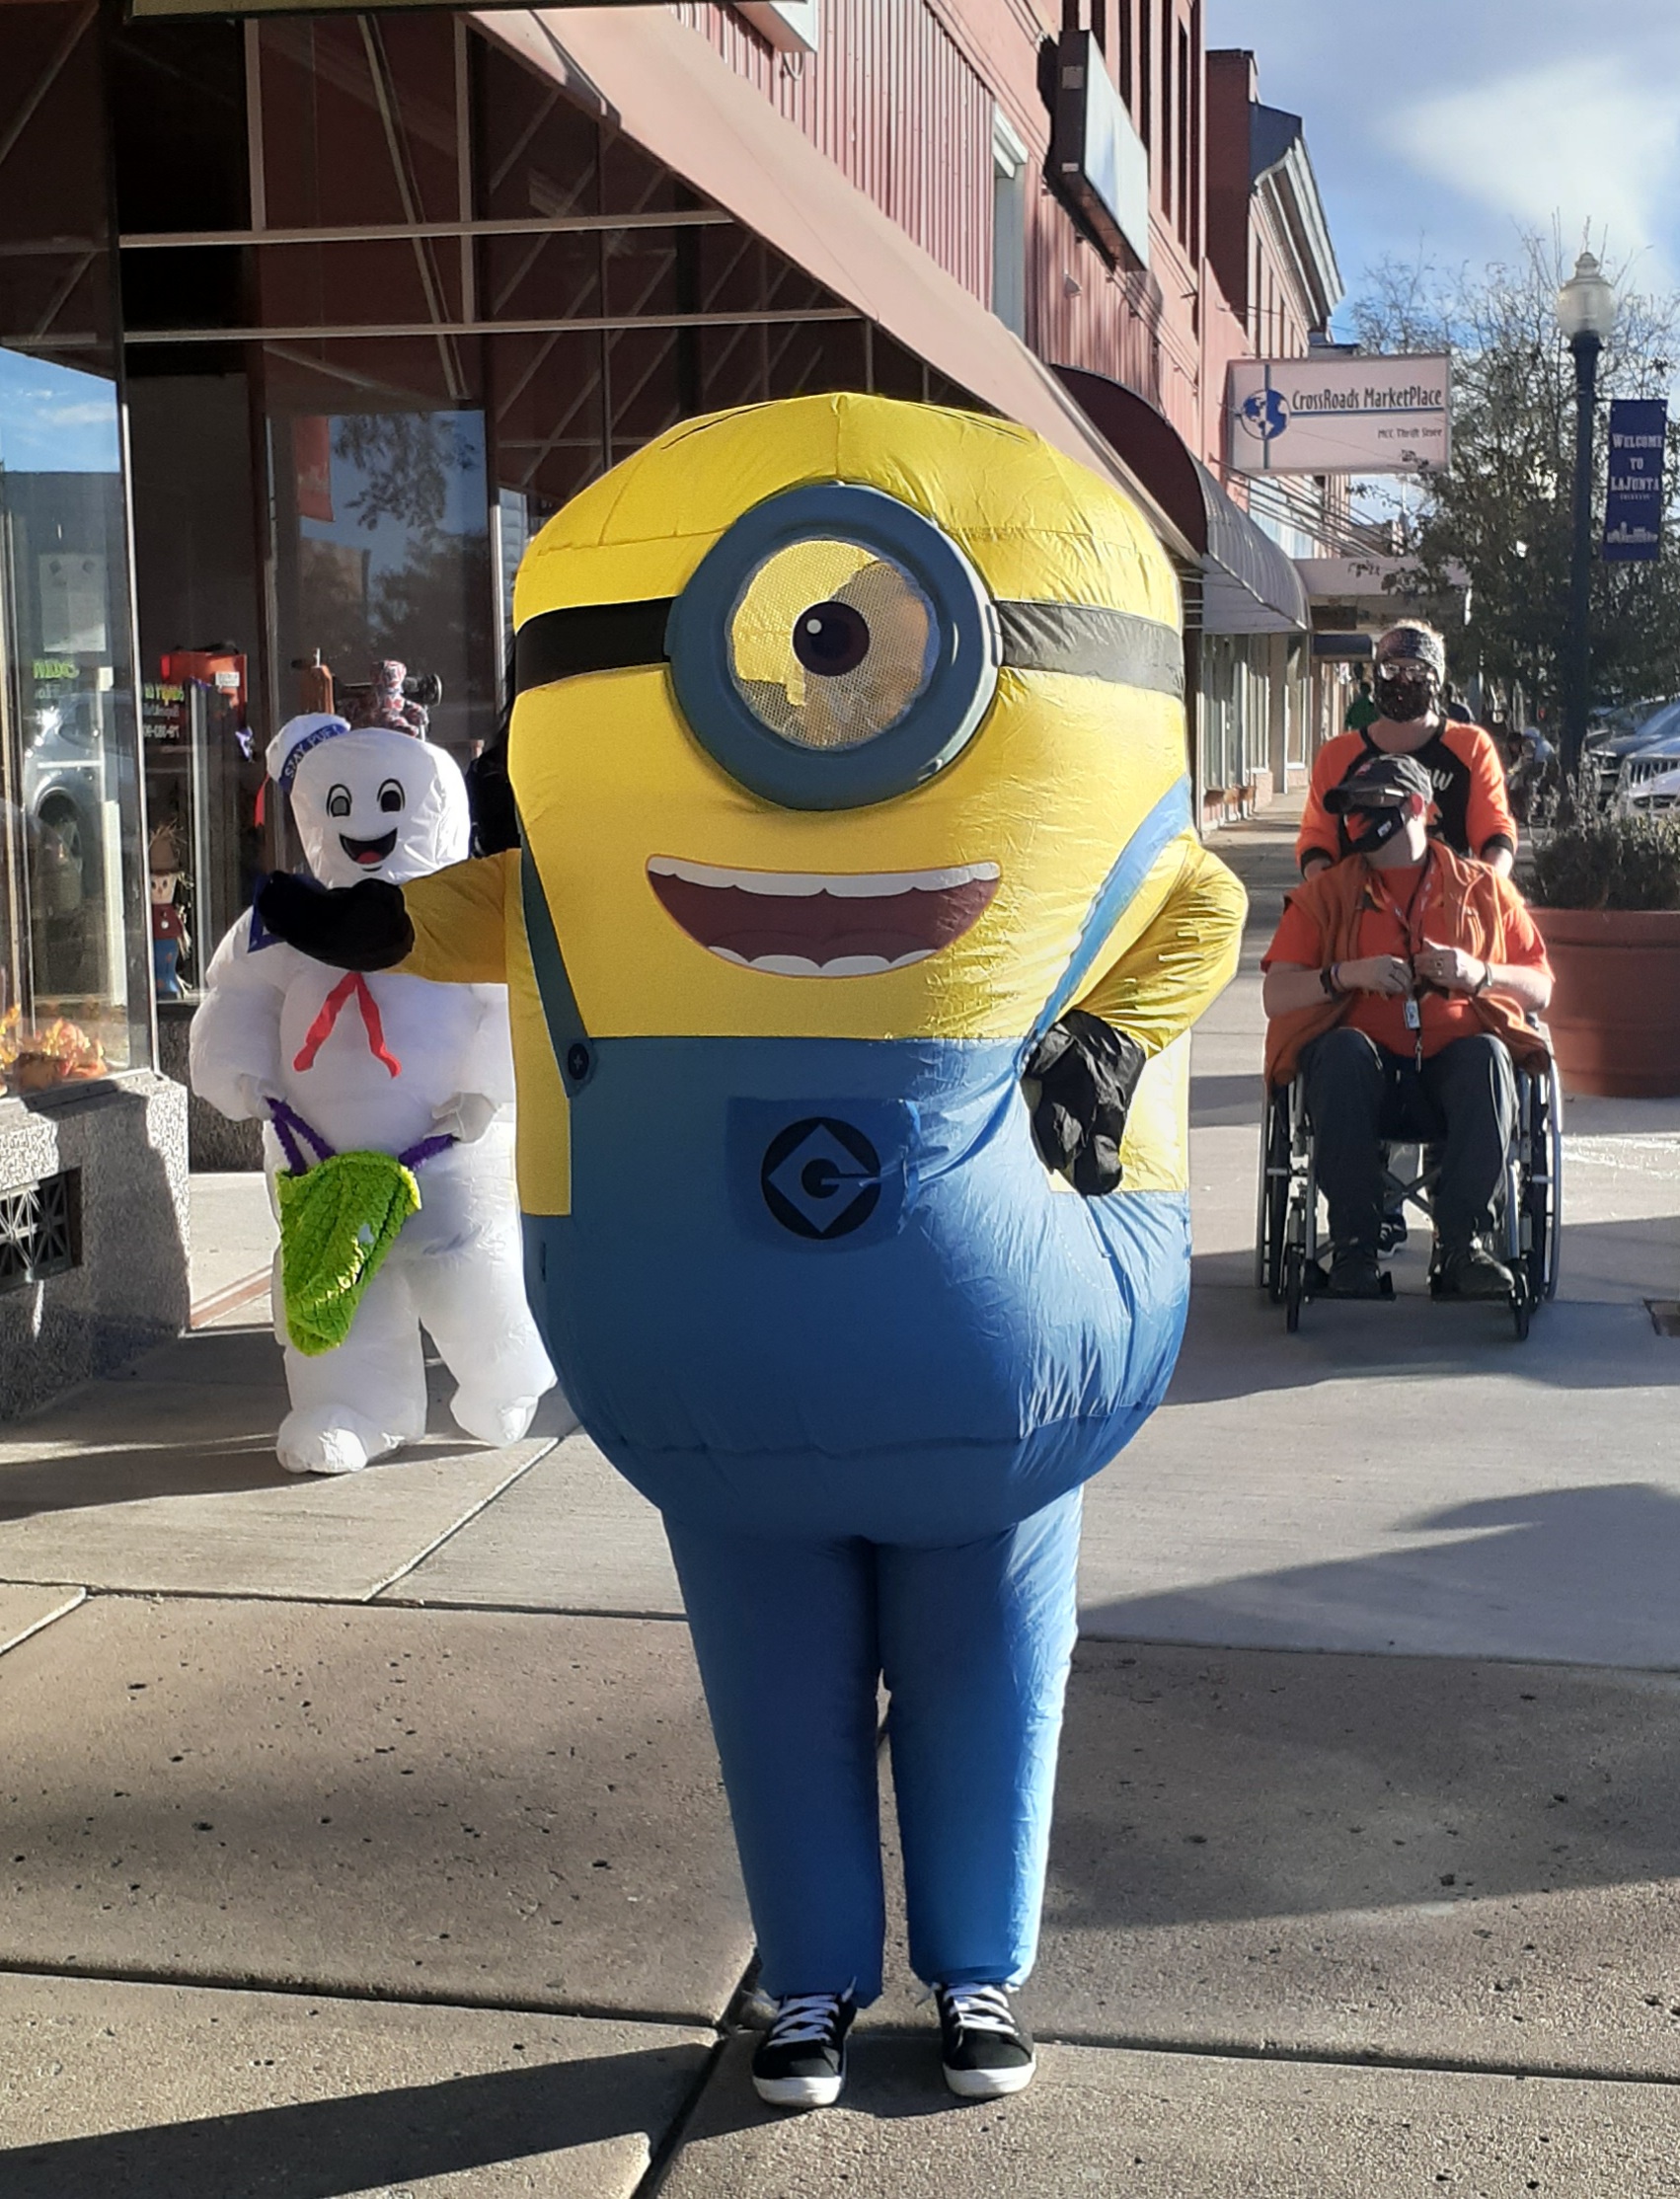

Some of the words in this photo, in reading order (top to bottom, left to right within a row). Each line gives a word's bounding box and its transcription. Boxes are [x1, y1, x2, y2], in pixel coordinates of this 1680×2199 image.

[1292, 388, 1359, 410] CrossRoads
[1364, 385, 1442, 409] MarketPlace
[1612, 433, 1662, 448] WELCOME
[1630, 457, 1644, 470] TO
[285, 743, 306, 778] STAY
